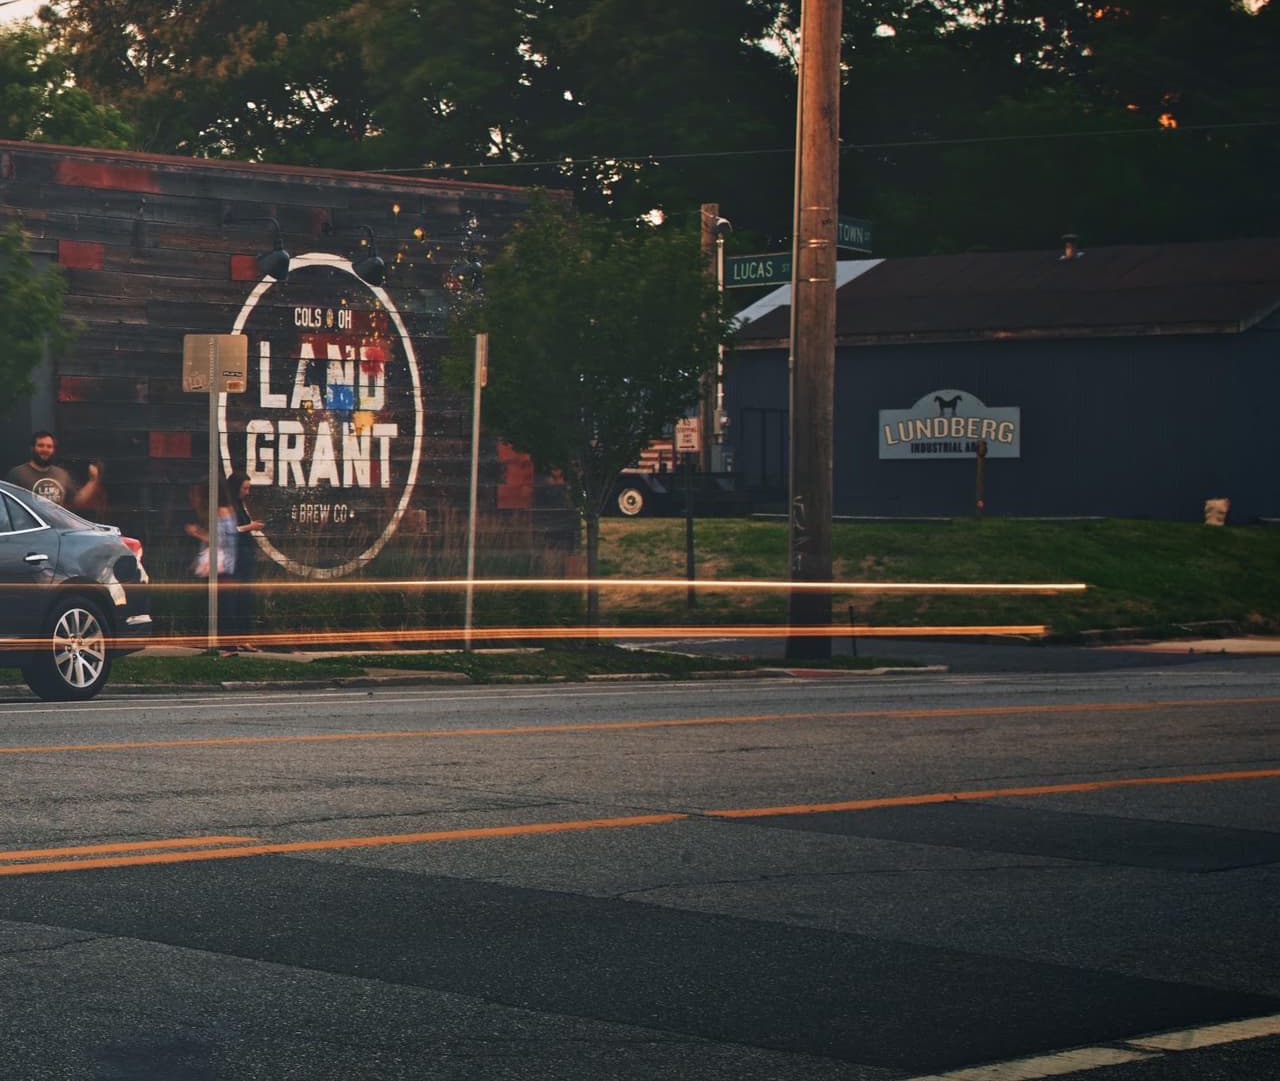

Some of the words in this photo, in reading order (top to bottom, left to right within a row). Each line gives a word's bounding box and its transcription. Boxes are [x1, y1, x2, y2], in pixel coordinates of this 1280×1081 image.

[838, 223, 864, 243] TOWN
[733, 261, 773, 280] LUCAS
[294, 307, 322, 328] COLS
[338, 309, 352, 329] OH
[260, 340, 385, 410] LAND
[884, 416, 1015, 446] LUNDBERG
[246, 420, 398, 488] GRANT
[911, 441, 963, 454] INDUSTRIAL
[299, 503, 330, 523] BREW
[333, 503, 348, 523] CO
